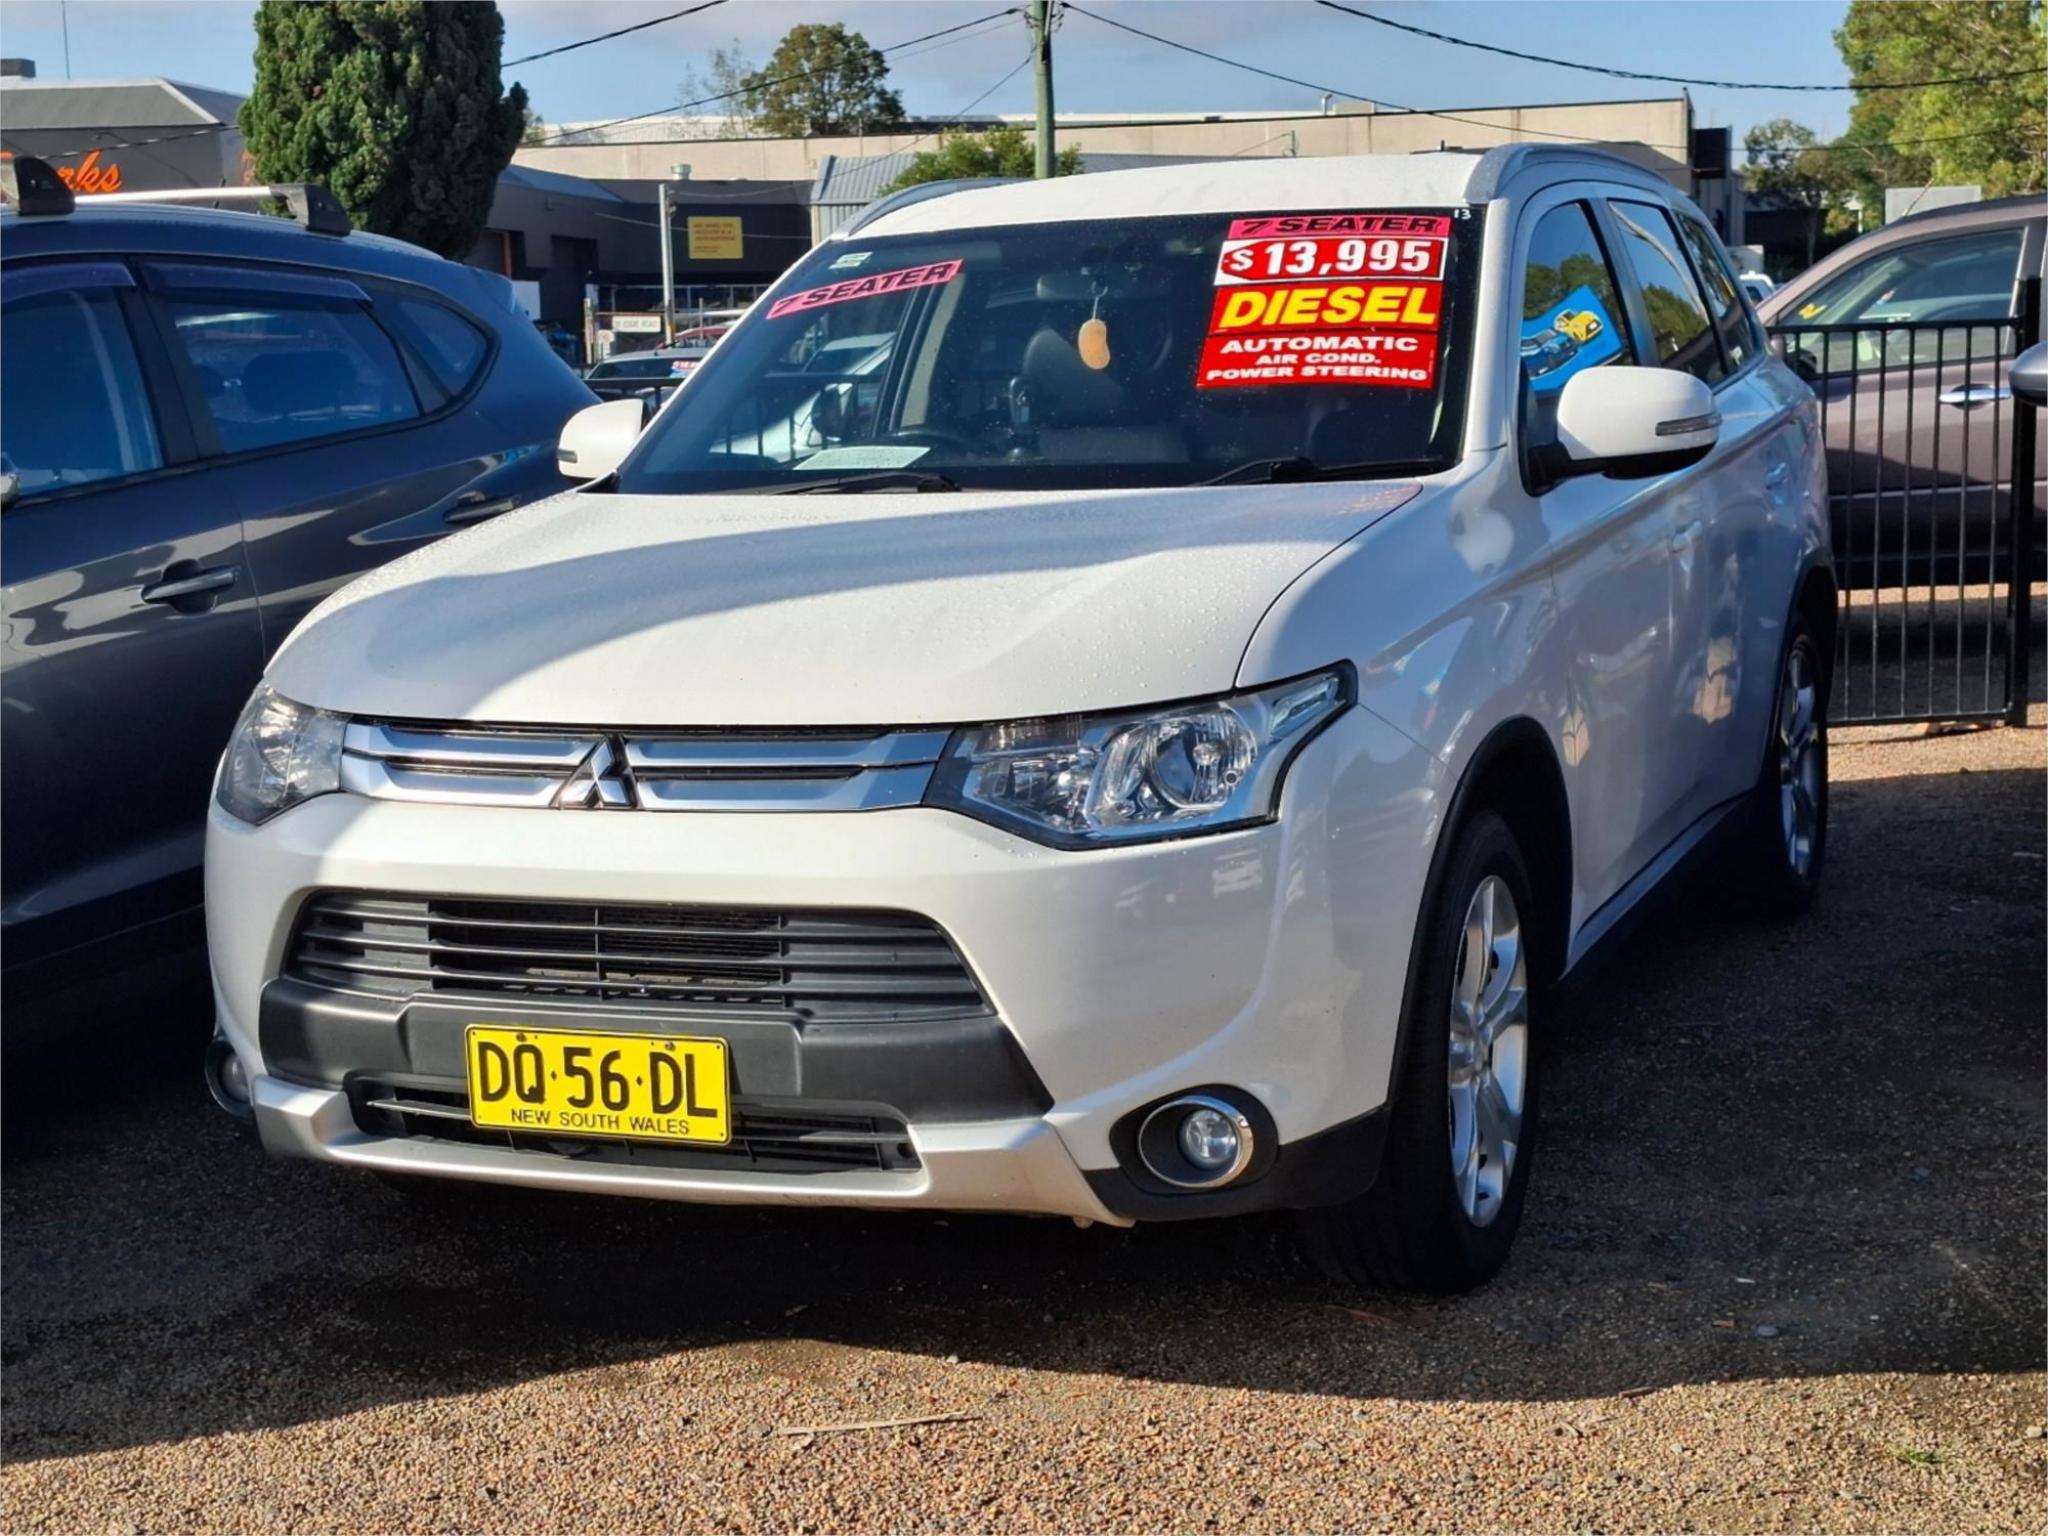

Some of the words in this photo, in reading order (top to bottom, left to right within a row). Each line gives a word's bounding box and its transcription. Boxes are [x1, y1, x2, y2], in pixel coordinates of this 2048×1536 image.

[1242, 220, 1272, 235] 7
[1276, 217, 1440, 232] SEATER
[771, 299, 799, 315] 7
[802, 263, 953, 305] SEATER
[1218, 286, 1436, 328] DIESEL
[1220, 336, 1419, 354] AUTOMATIC
[1255, 353, 1298, 365] AIR
[1305, 353, 1381, 364] COND.
[1206, 366, 1294, 381] POWER
[1301, 365, 1428, 381] STEERING
[511, 1108, 551, 1125] NEW
[559, 1111, 620, 1130] SOUTH
[630, 1116, 690, 1135] WALES
